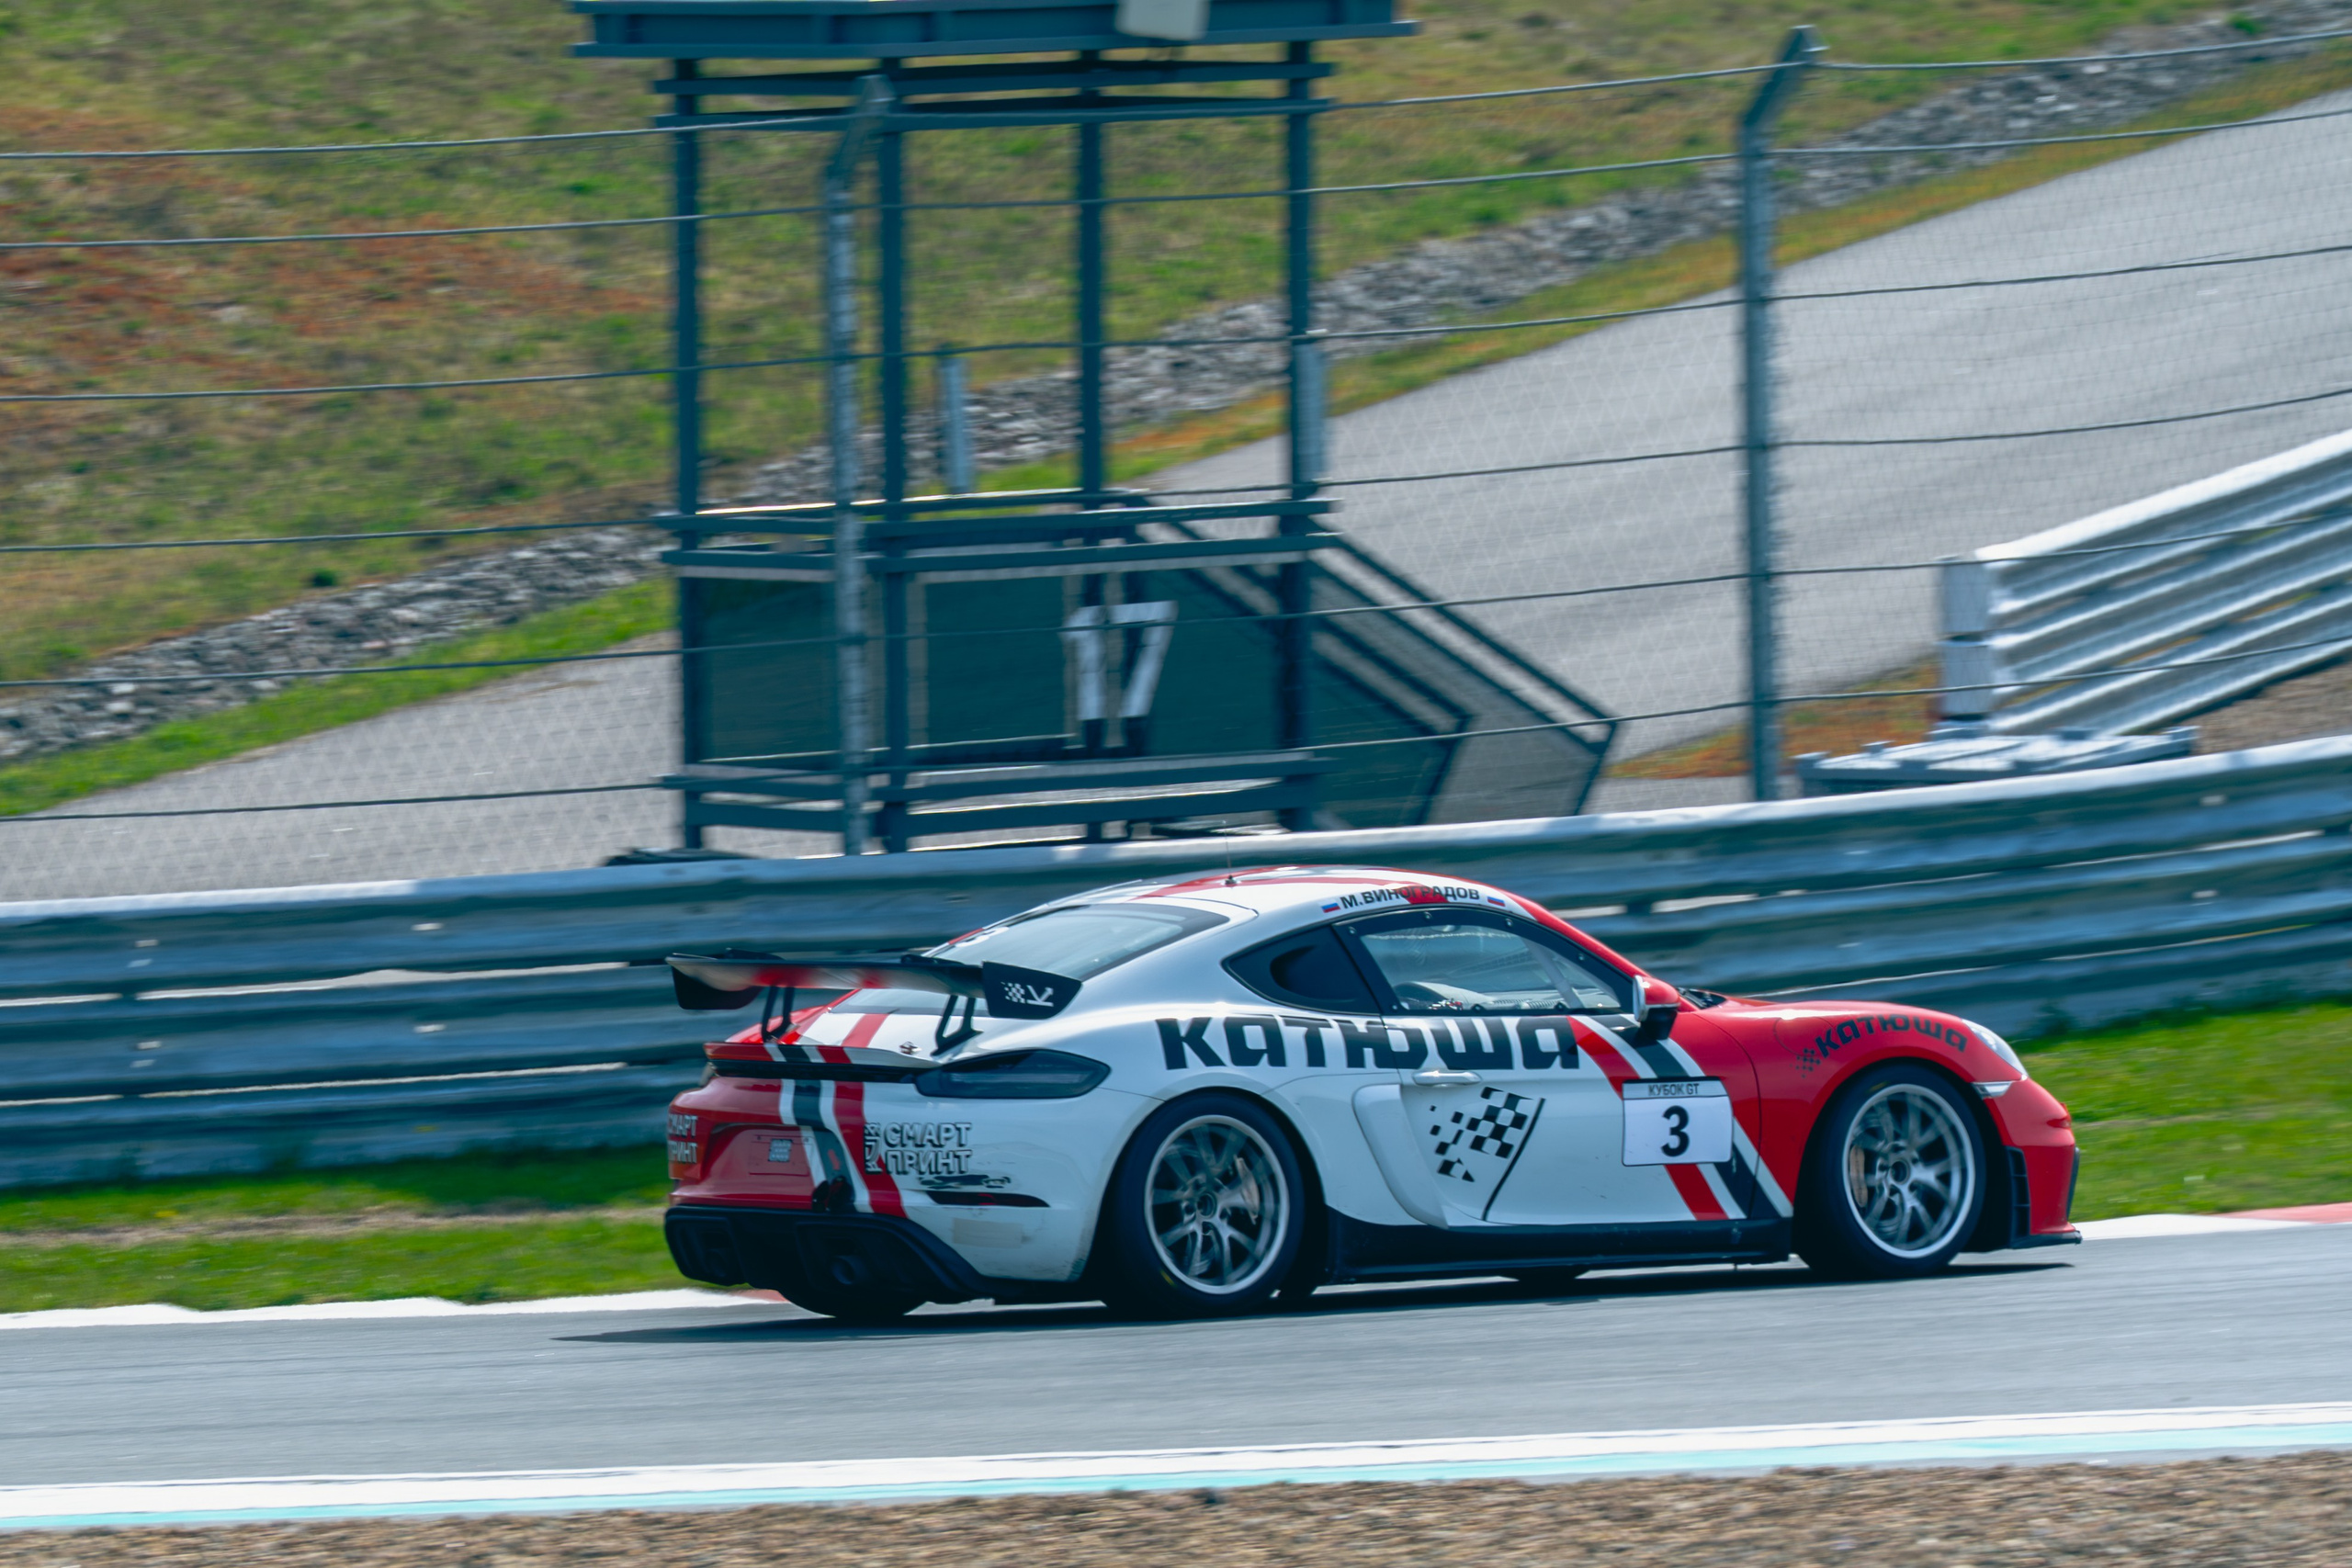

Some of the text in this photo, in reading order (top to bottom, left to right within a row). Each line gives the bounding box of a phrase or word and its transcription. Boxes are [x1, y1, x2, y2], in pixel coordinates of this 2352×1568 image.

[1059, 600, 1179, 721] 17
[1647, 1083, 1701, 1097] КУБОК GT
[883, 1122, 973, 1148] СМАРТ
[1660, 1105, 1690, 1158] 3
[884, 1149, 973, 1176] ПРИНТ
